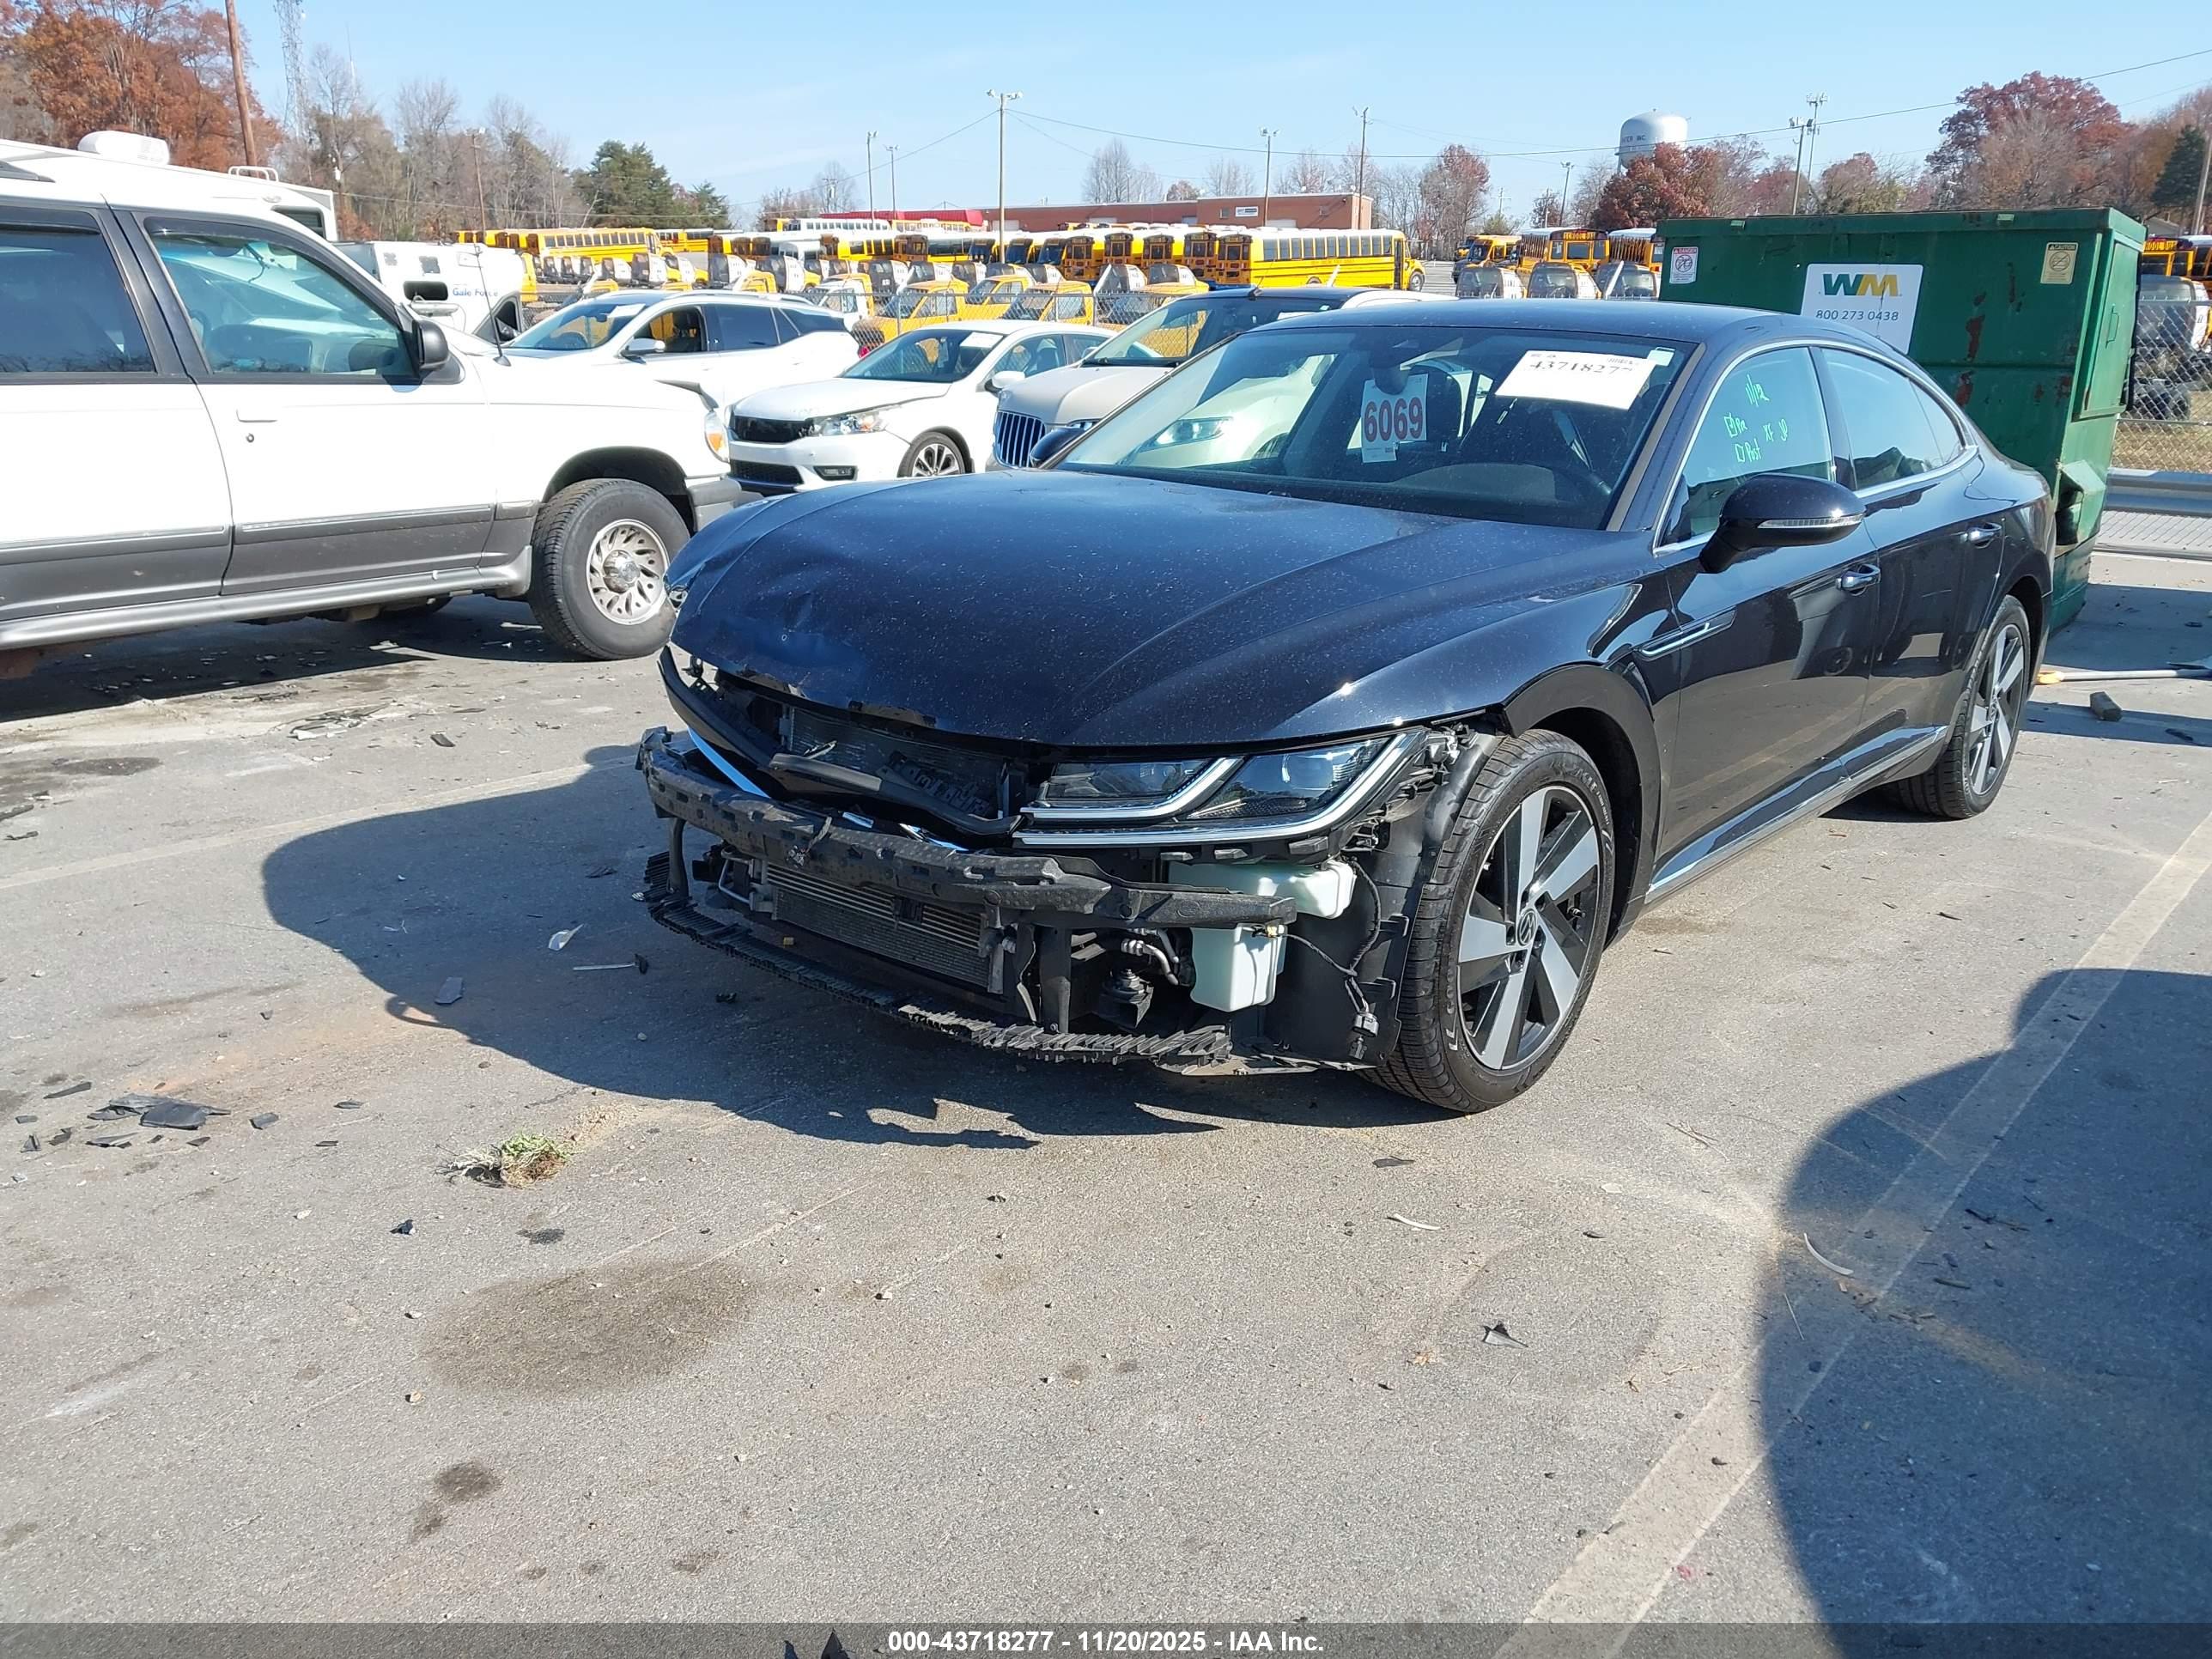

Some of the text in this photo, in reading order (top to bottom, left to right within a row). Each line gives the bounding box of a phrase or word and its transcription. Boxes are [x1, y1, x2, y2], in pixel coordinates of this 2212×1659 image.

[453, 288, 471, 296] Gale
[1822, 273, 1899, 296] WM
[1815, 309, 1899, 321] 800 273 0438
[1364, 397, 1424, 443] 6069
